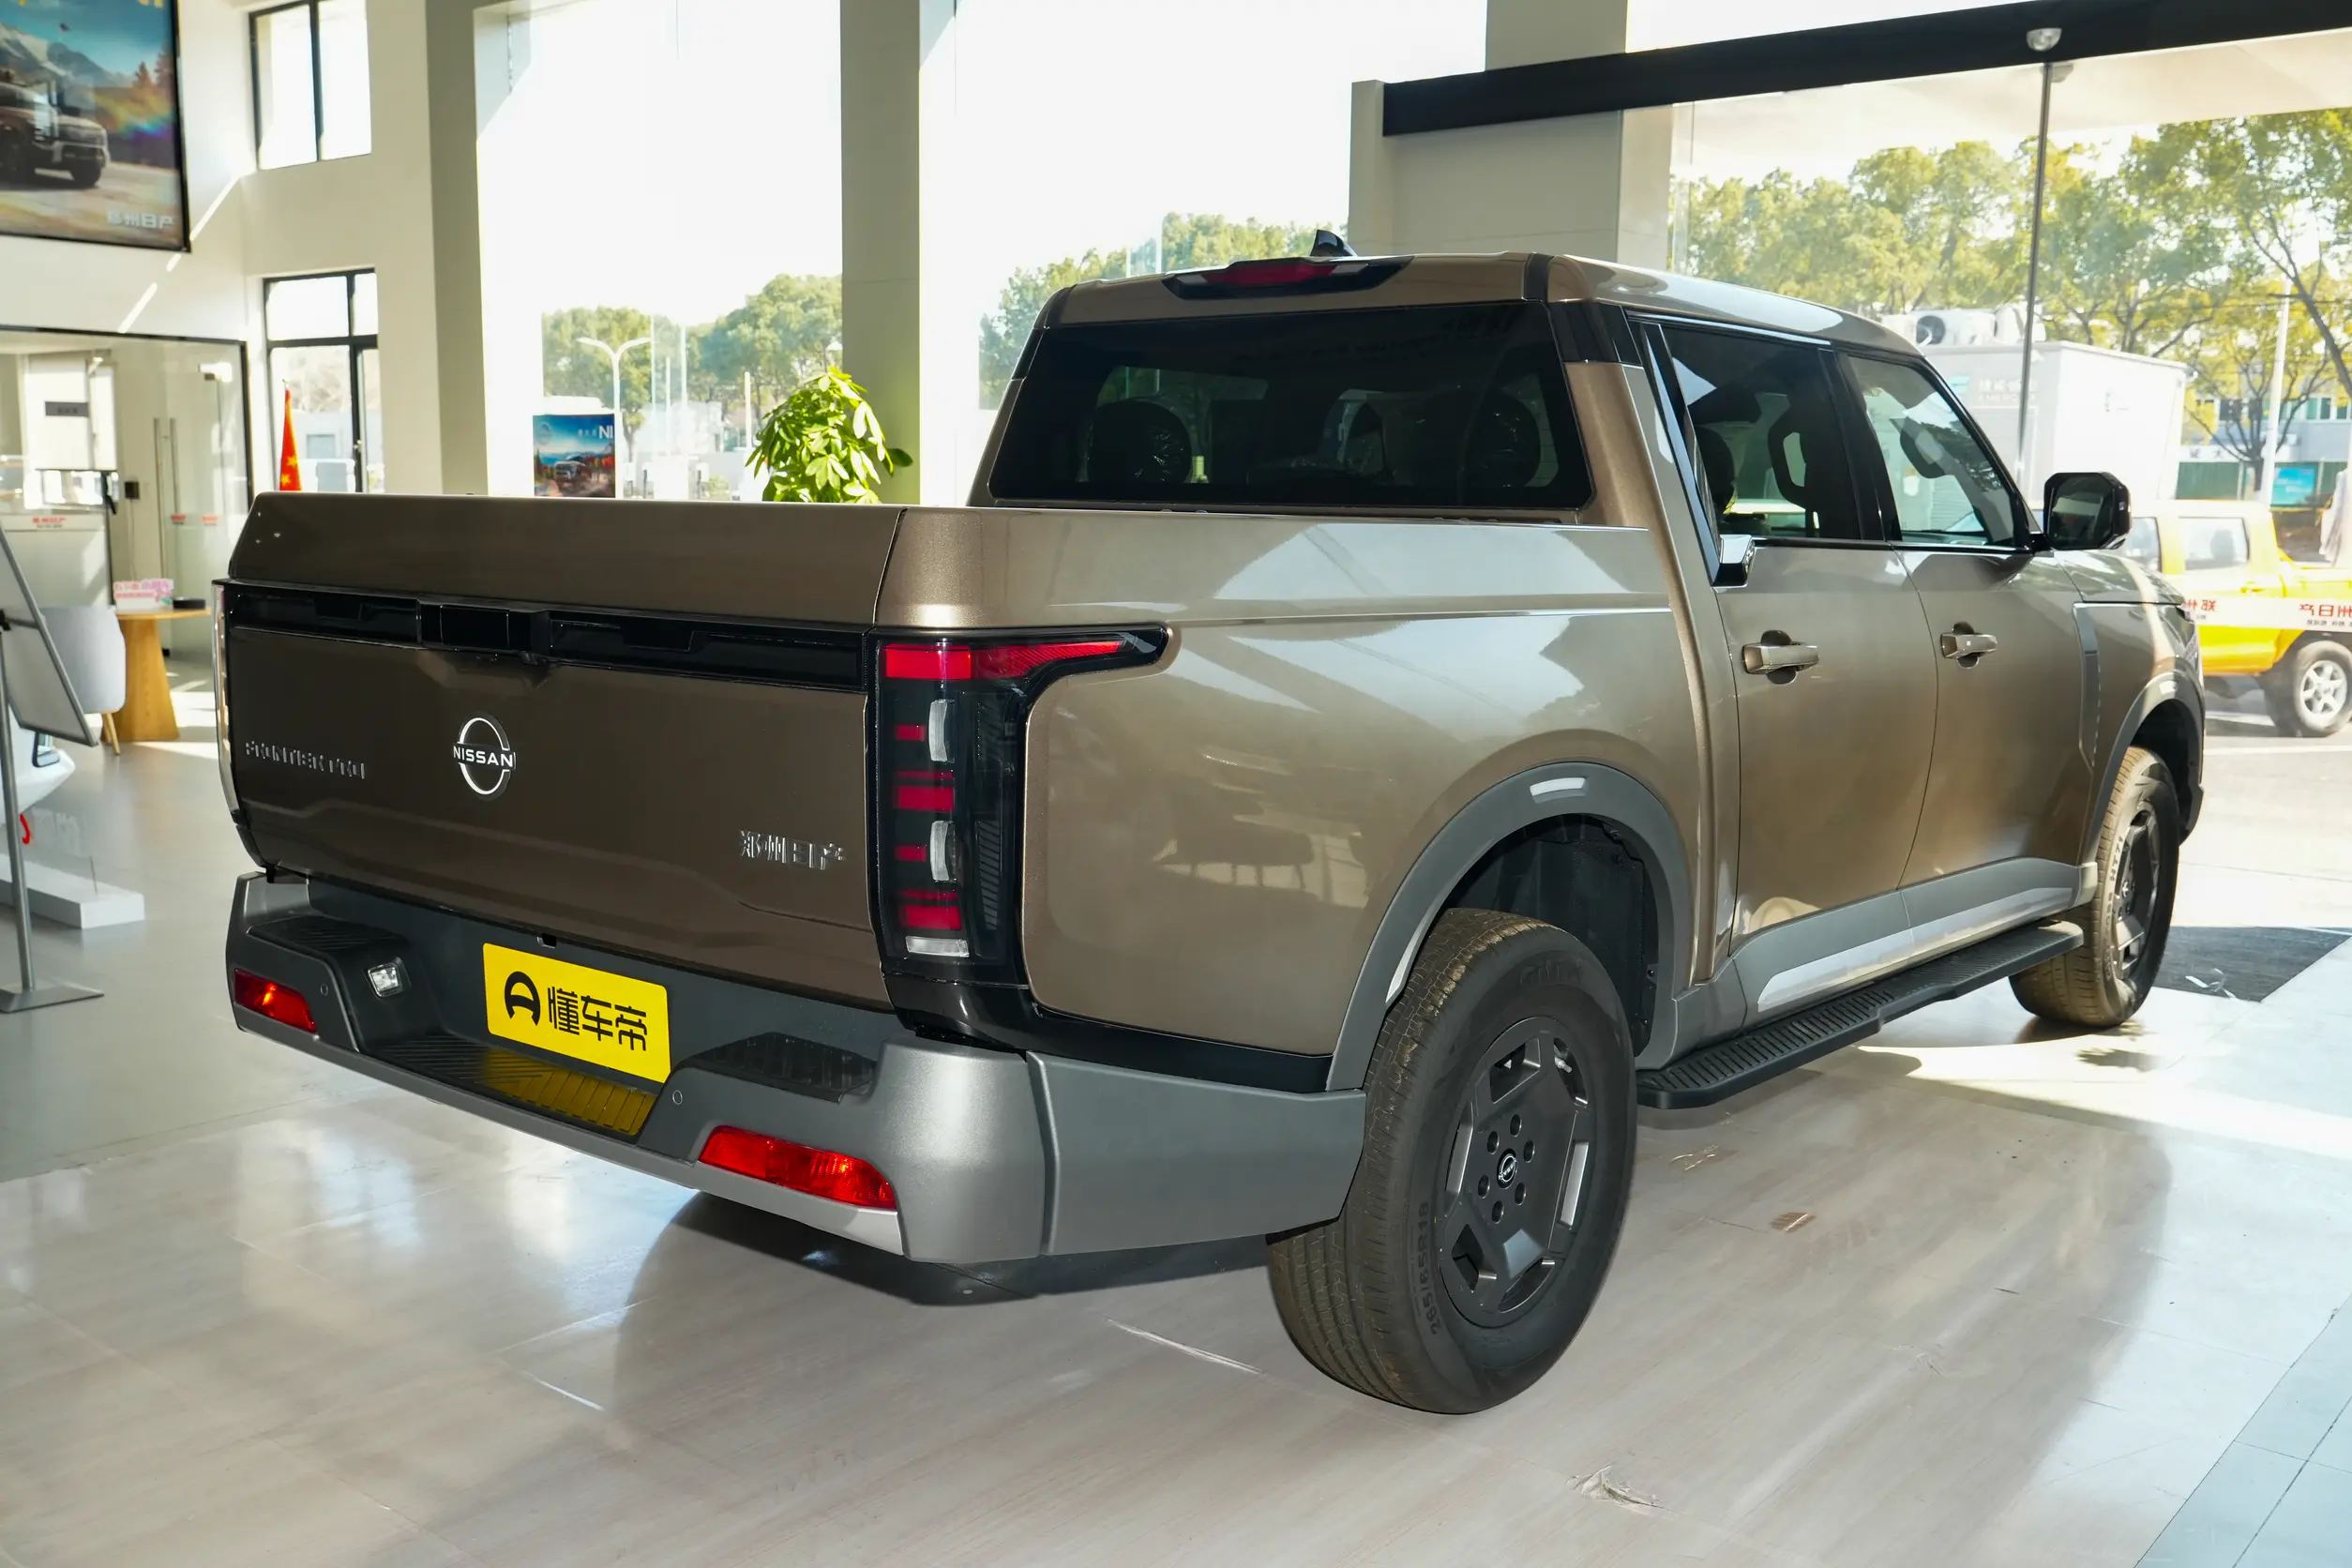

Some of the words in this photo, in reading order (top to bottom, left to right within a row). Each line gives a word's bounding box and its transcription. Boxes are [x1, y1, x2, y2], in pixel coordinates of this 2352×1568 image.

[453, 746, 513, 767] NISSAN
[739, 829, 844, 870] 郑州日产
[548, 986, 647, 1051] 懂车帝
